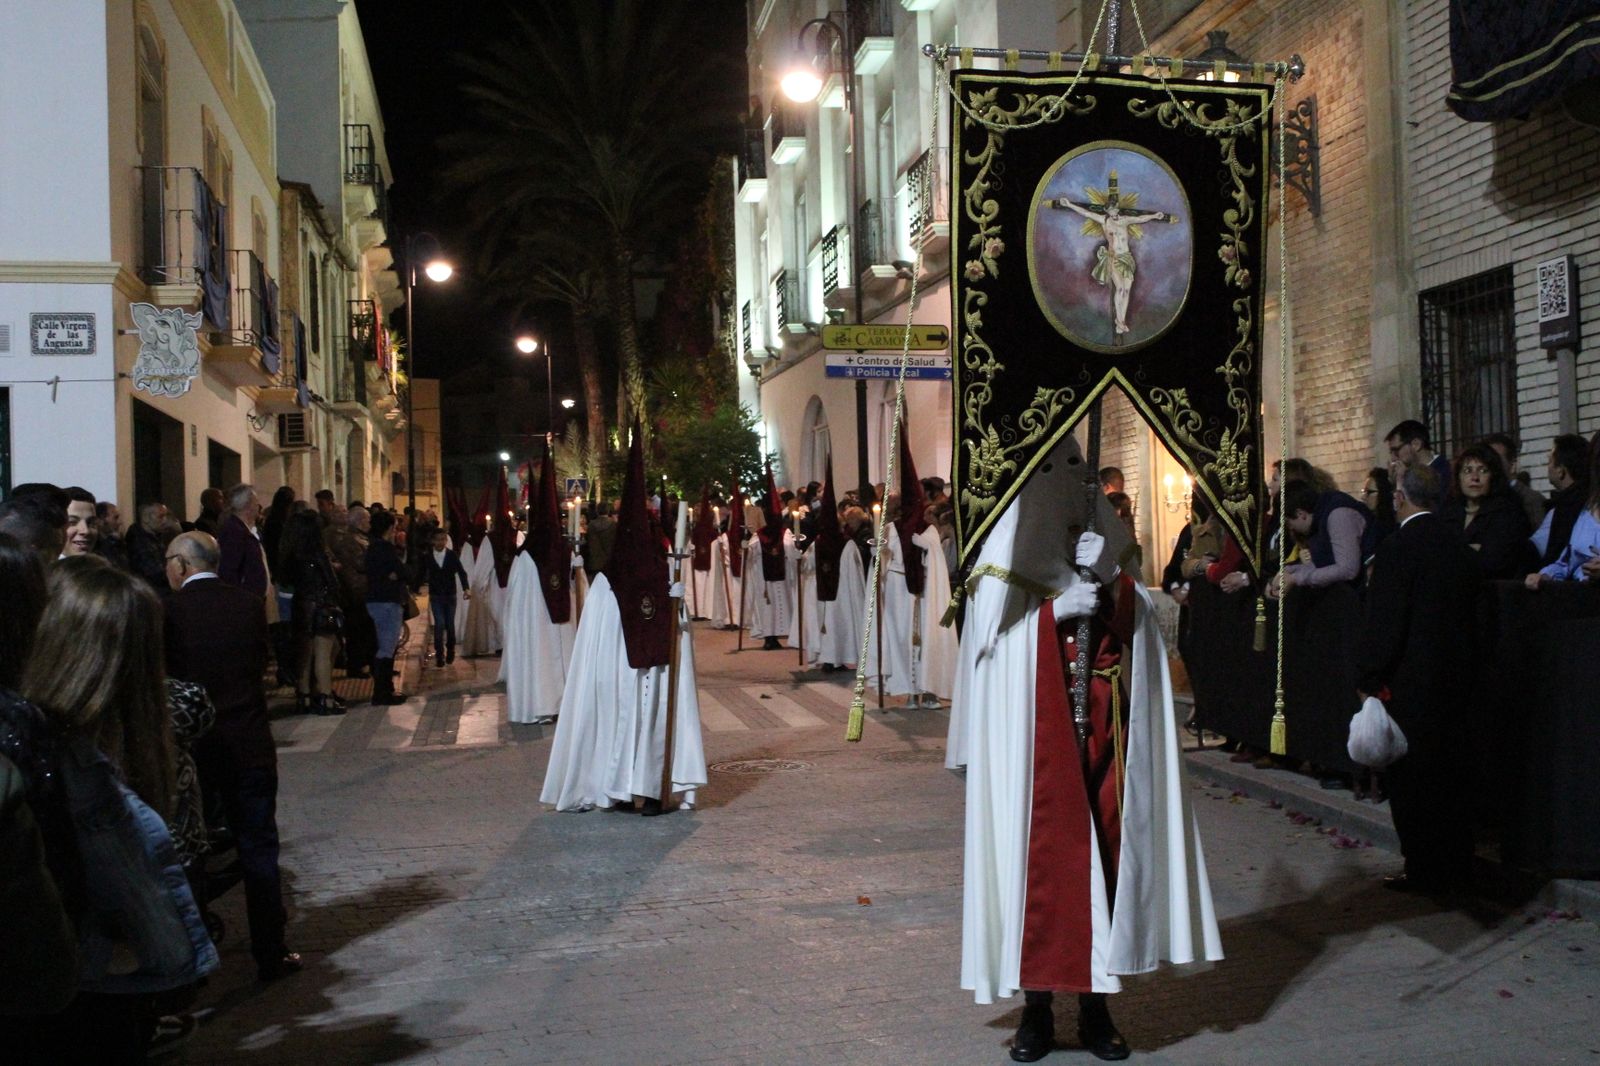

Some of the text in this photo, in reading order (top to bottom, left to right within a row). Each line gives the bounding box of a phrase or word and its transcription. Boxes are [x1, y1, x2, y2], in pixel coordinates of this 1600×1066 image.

[38, 320, 87, 331] Calle Virgen
[46, 330, 80, 339] de las
[43, 339, 83, 349] Angustias
[857, 357, 890, 366] Centro
[908, 358, 935, 367] Salud
